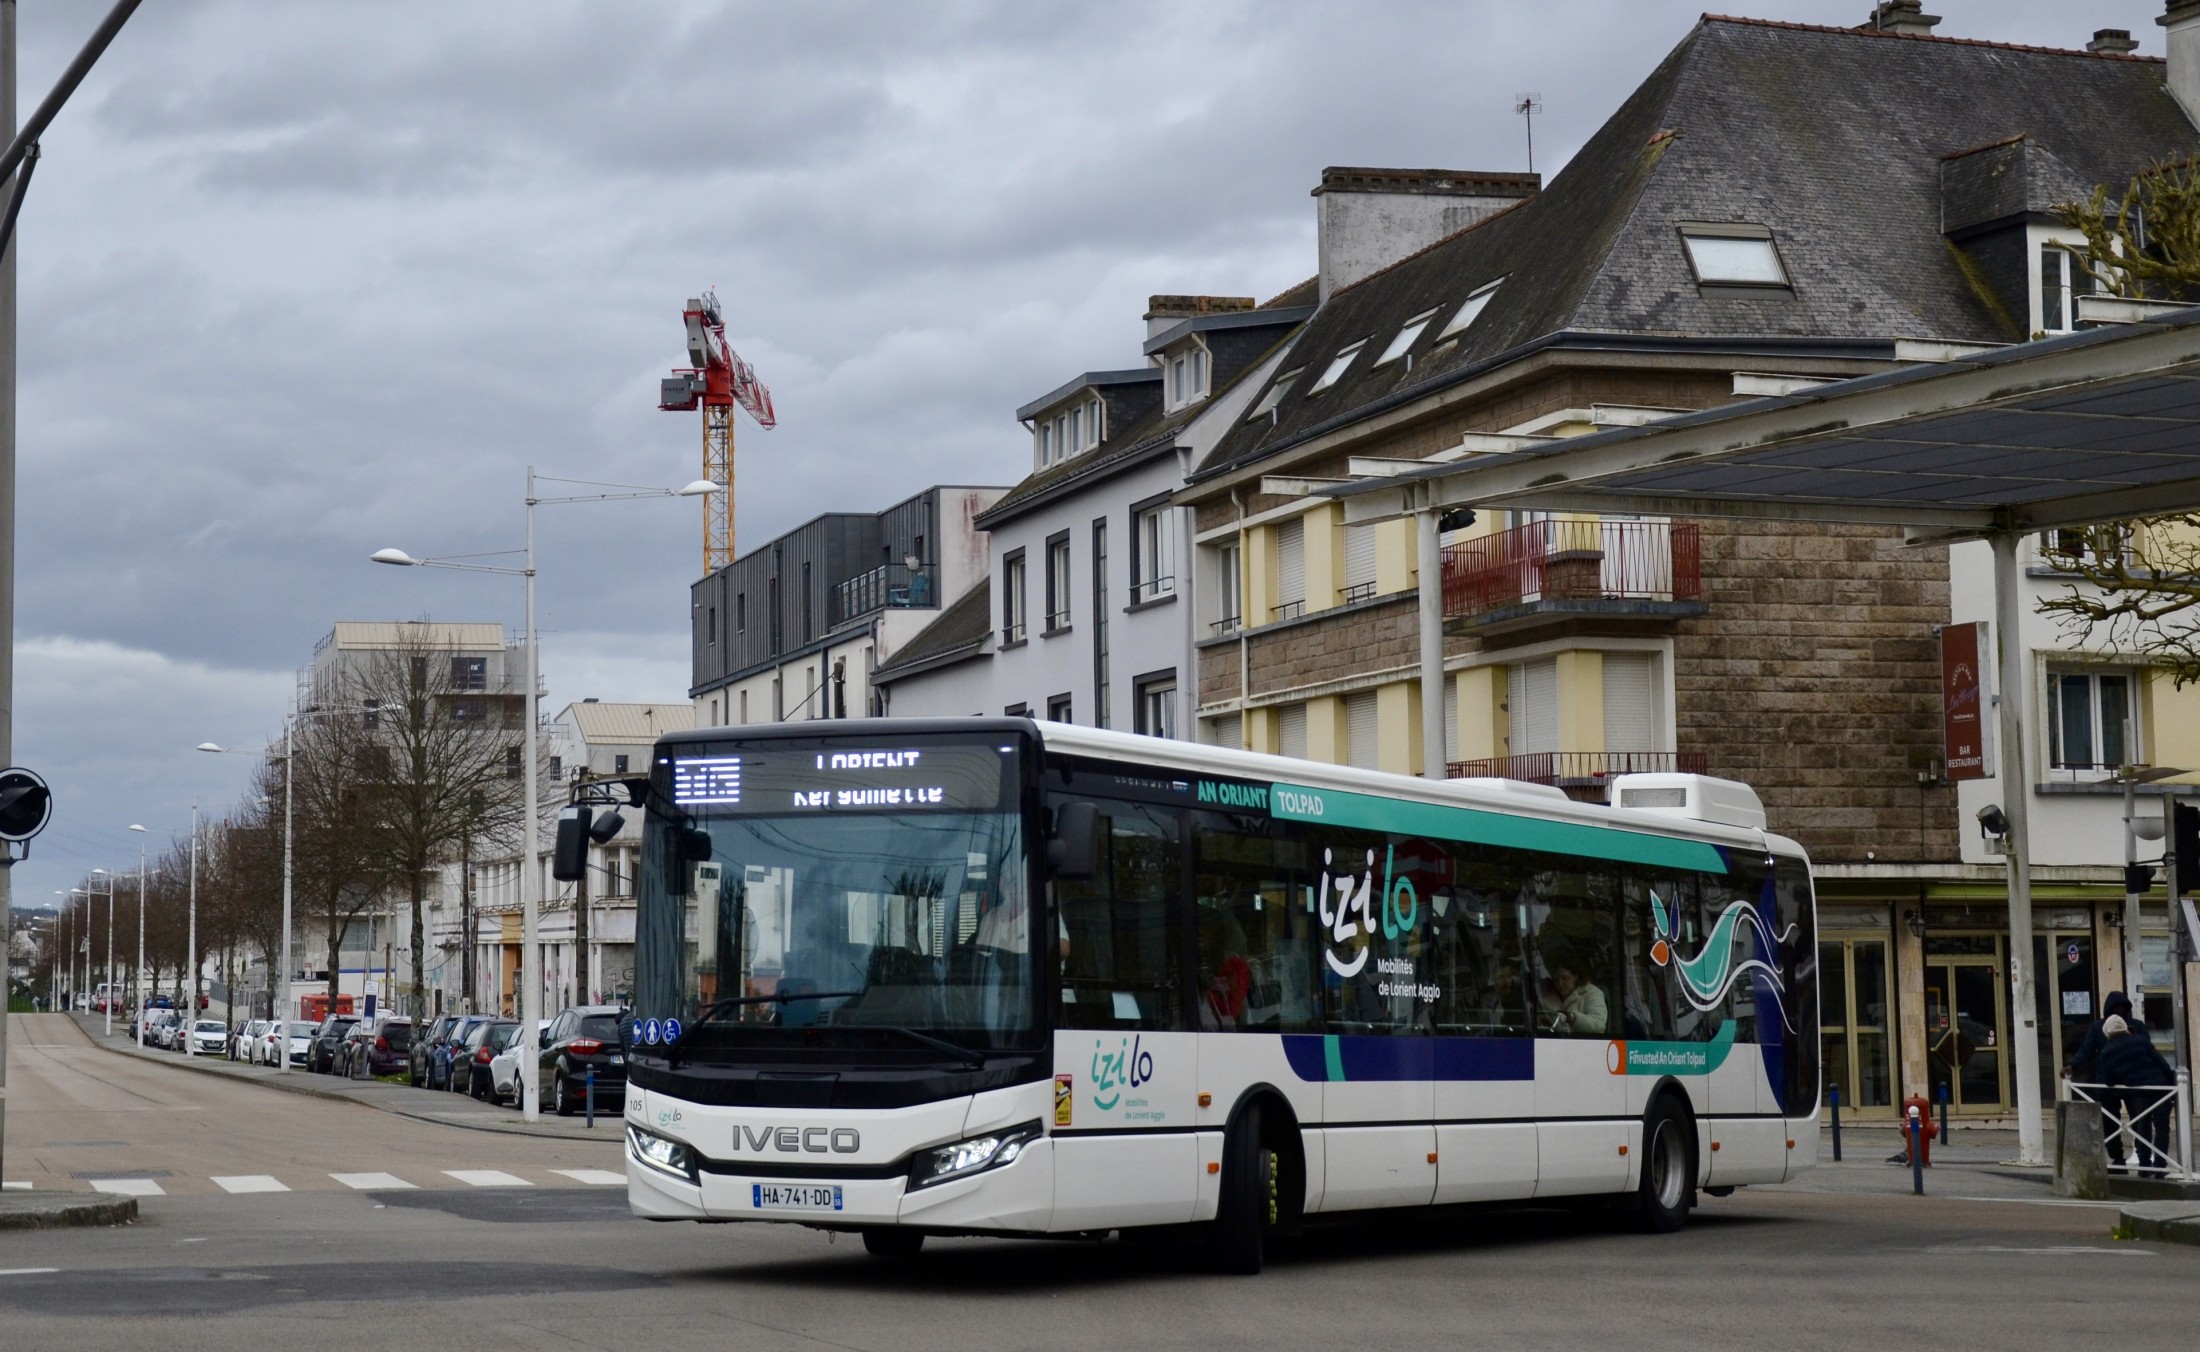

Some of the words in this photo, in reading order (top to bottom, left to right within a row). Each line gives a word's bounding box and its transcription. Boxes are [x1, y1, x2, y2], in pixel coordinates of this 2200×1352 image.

[1959, 745, 1971, 756] BAR
[1948, 756, 1982, 769] RESTAURANT
[1197, 780, 1217, 803] AN
[1219, 782, 1268, 809] ORIANT
[1277, 790, 1324, 816] TOLPAD
[1377, 957, 1414, 975] Mobilités
[1378, 980, 1389, 996] de
[1390, 981, 1417, 998] Lorient
[1417, 983, 1441, 1003] Agglo
[1659, 1050, 1667, 1065] An
[1667, 1051, 1686, 1065] Oriant
[1686, 1051, 1706, 1069] Tolpad
[630, 1099, 643, 1111] 105
[1132, 1111, 1150, 1121] Lorient
[1150, 1111, 1166, 1123] Agglo
[732, 1125, 860, 1154] IVECO
[762, 1187, 832, 1206] HA-741-DD
